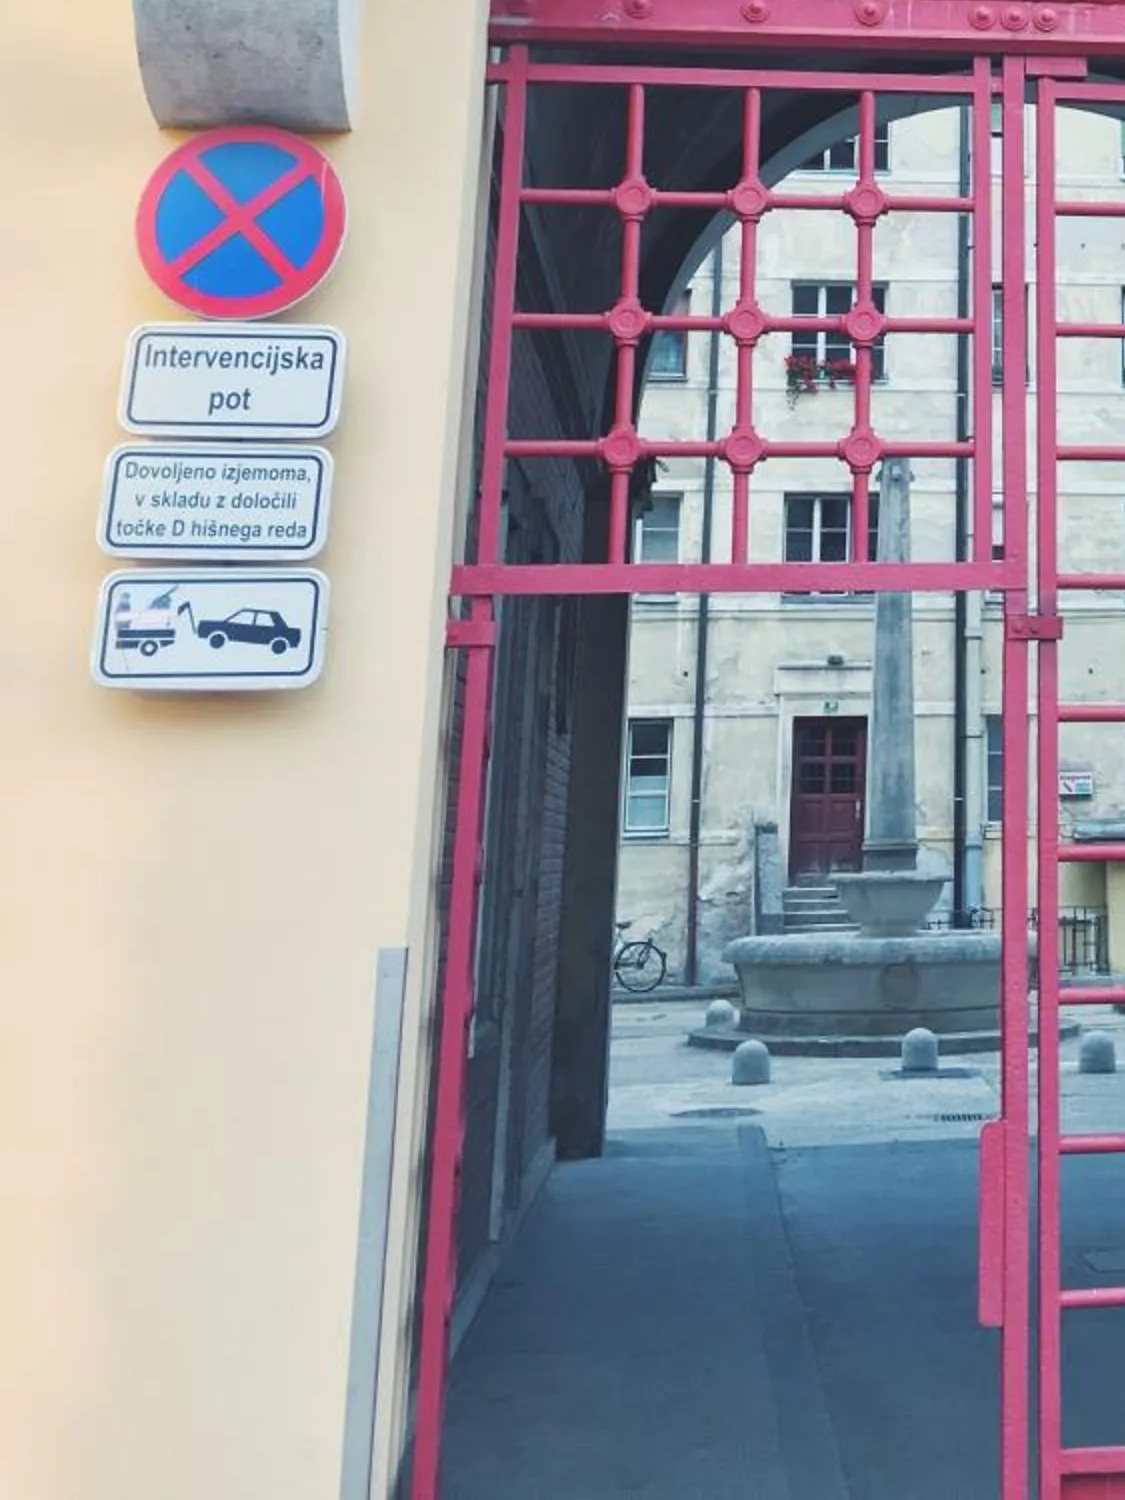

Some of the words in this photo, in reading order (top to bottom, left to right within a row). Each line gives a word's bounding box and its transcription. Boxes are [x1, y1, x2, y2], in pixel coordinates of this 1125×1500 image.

[145, 344, 324, 376] Intervencijska
[208, 387, 251, 415] pot
[125, 461, 216, 483] Dovoljeno
[222, 463, 311, 484] izjemoma,
[135, 494, 145, 507] v
[151, 491, 210, 509] skladu
[216, 495, 225, 508] z
[231, 491, 297, 509] določili
[117, 519, 166, 537] točke
[171, 520, 185, 536] D
[191, 520, 262, 541] hišnega
[267, 522, 307, 538] reda
